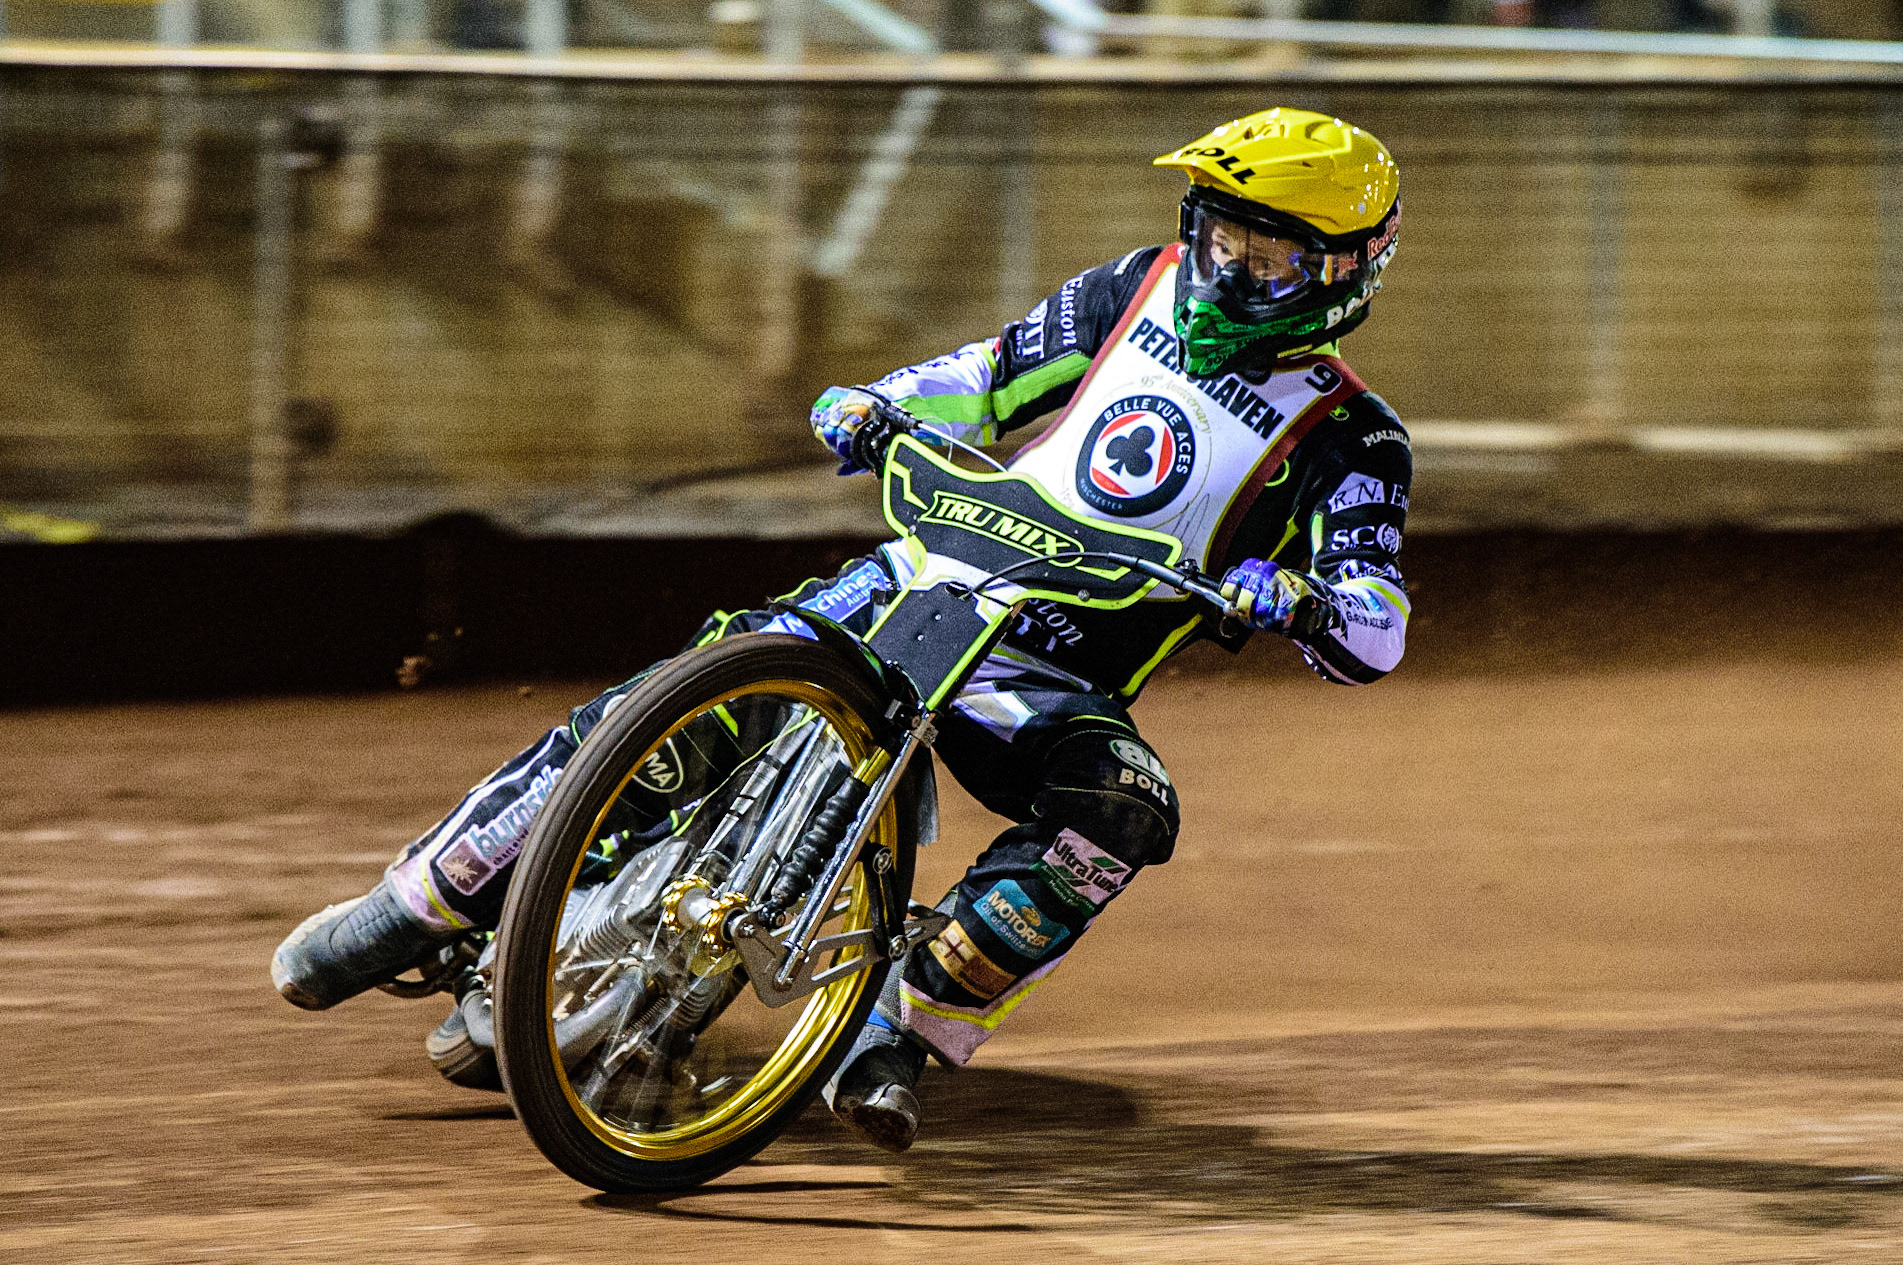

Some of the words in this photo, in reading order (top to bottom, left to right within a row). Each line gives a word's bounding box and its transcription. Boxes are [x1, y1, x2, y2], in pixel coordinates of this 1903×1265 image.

[1304, 363, 1342, 394] 9
[1187, 366, 1285, 440] RAVEN
[1103, 397, 1152, 422] BELLE
[1155, 399, 1183, 427] VUE
[1176, 431, 1192, 475] ACES
[936, 498, 997, 526] TRU
[991, 515, 1071, 556] MIX
[1118, 768, 1168, 806] BOLL
[980, 902, 994, 916] Oil
[990, 915, 1001, 927] of
